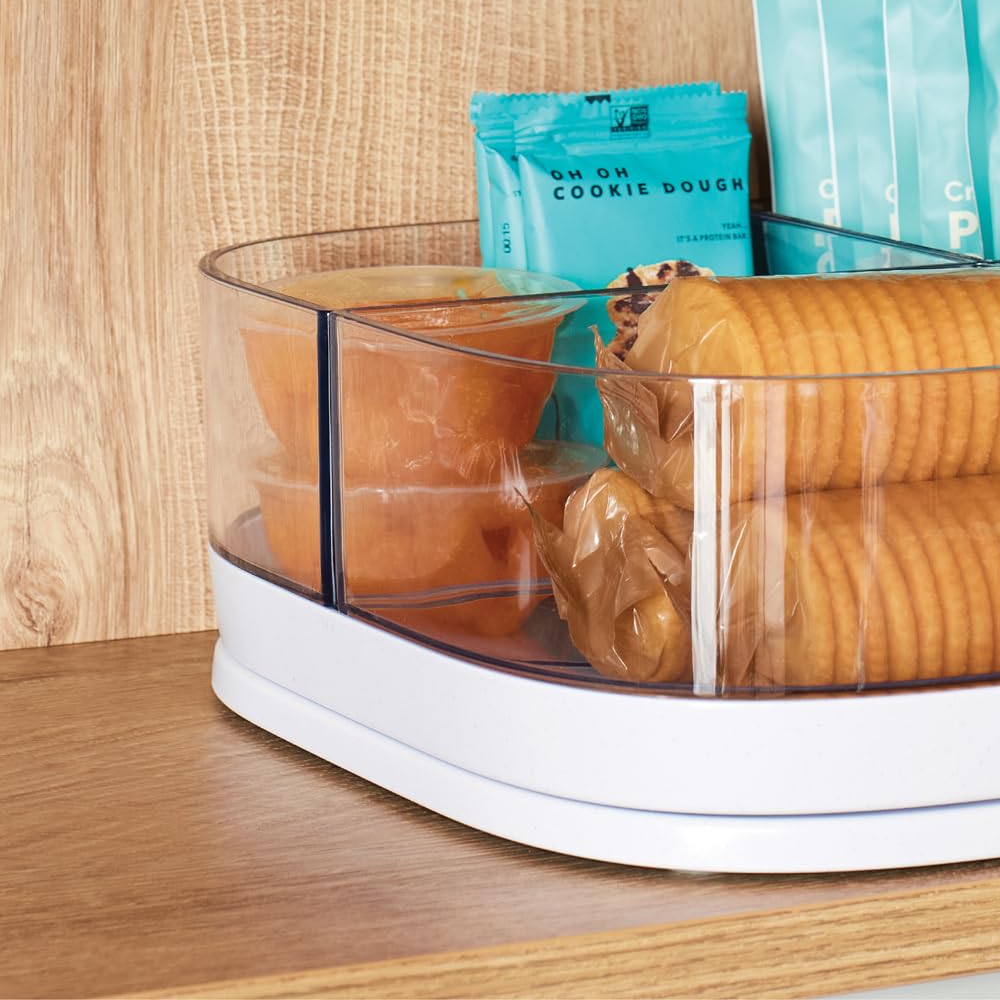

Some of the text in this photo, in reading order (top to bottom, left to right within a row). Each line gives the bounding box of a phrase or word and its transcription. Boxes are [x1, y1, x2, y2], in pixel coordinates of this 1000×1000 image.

[551, 167, 629, 181] OH OH
[553, 178, 744, 200] COOKIE DOUGH
